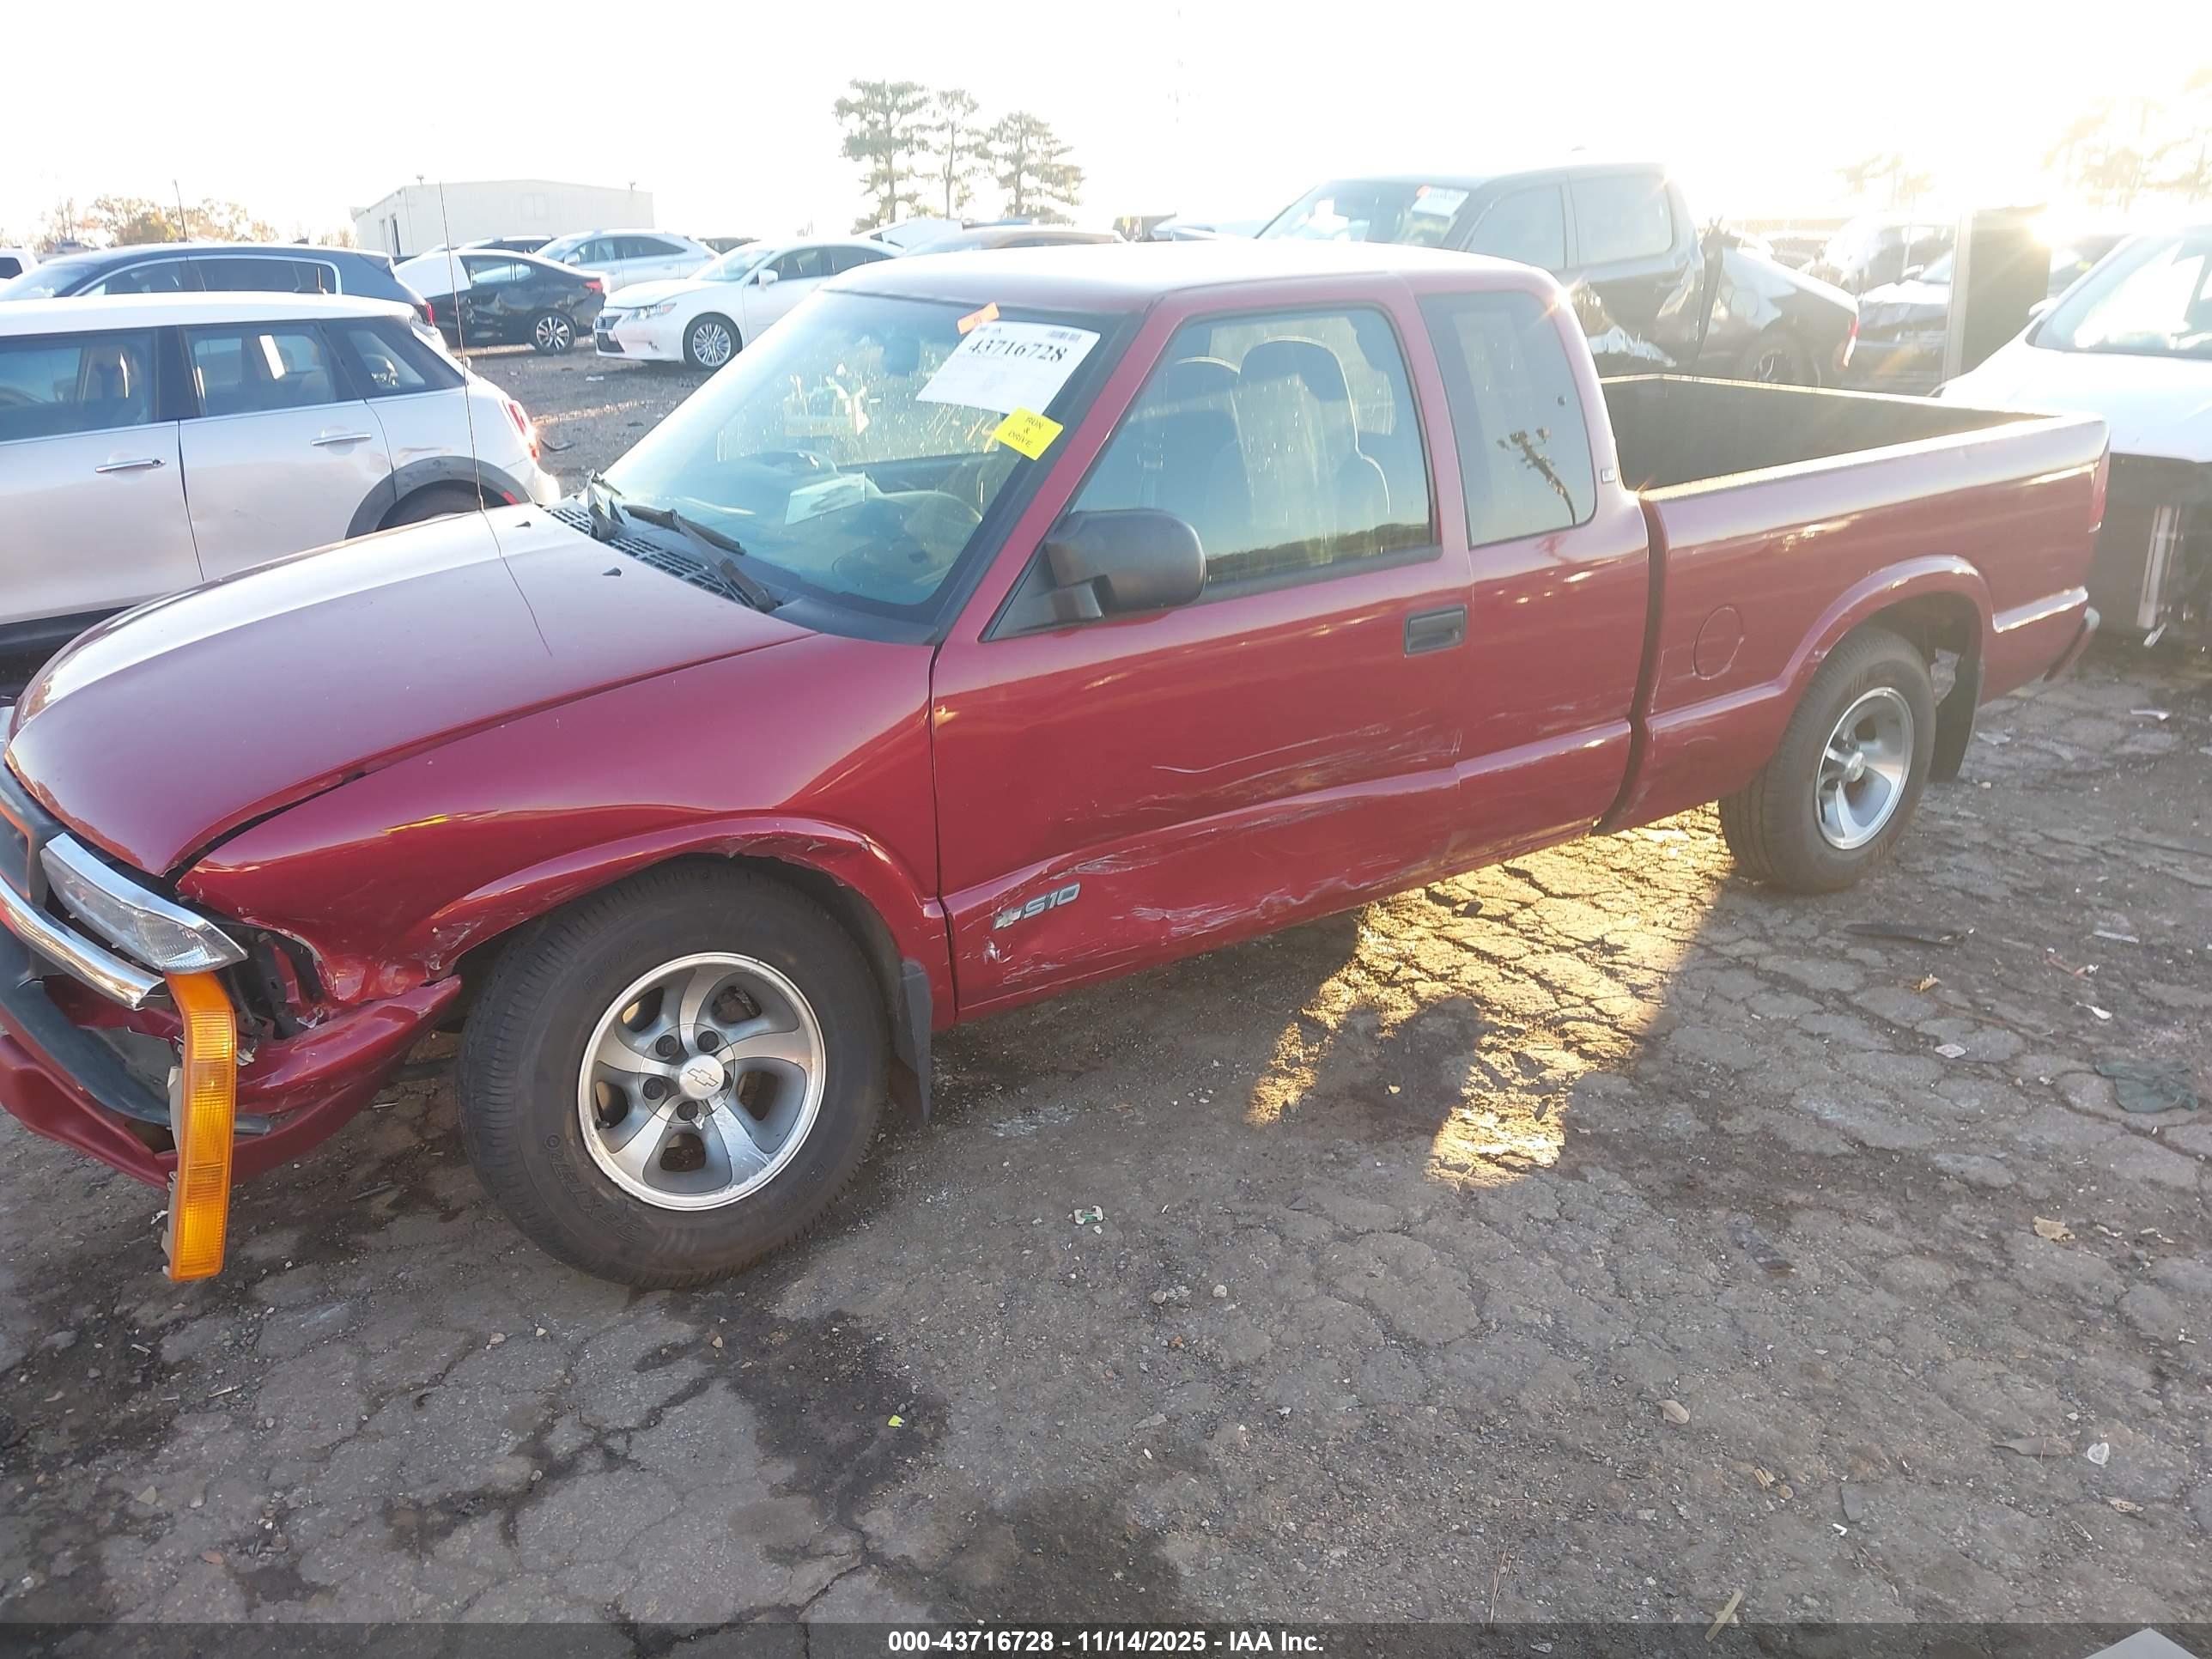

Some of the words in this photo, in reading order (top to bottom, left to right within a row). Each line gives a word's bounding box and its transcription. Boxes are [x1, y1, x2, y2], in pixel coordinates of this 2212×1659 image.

[969, 338, 1067, 362] 43716728
[1024, 416, 1045, 430] RUN
[1023, 882, 1081, 921] S10
